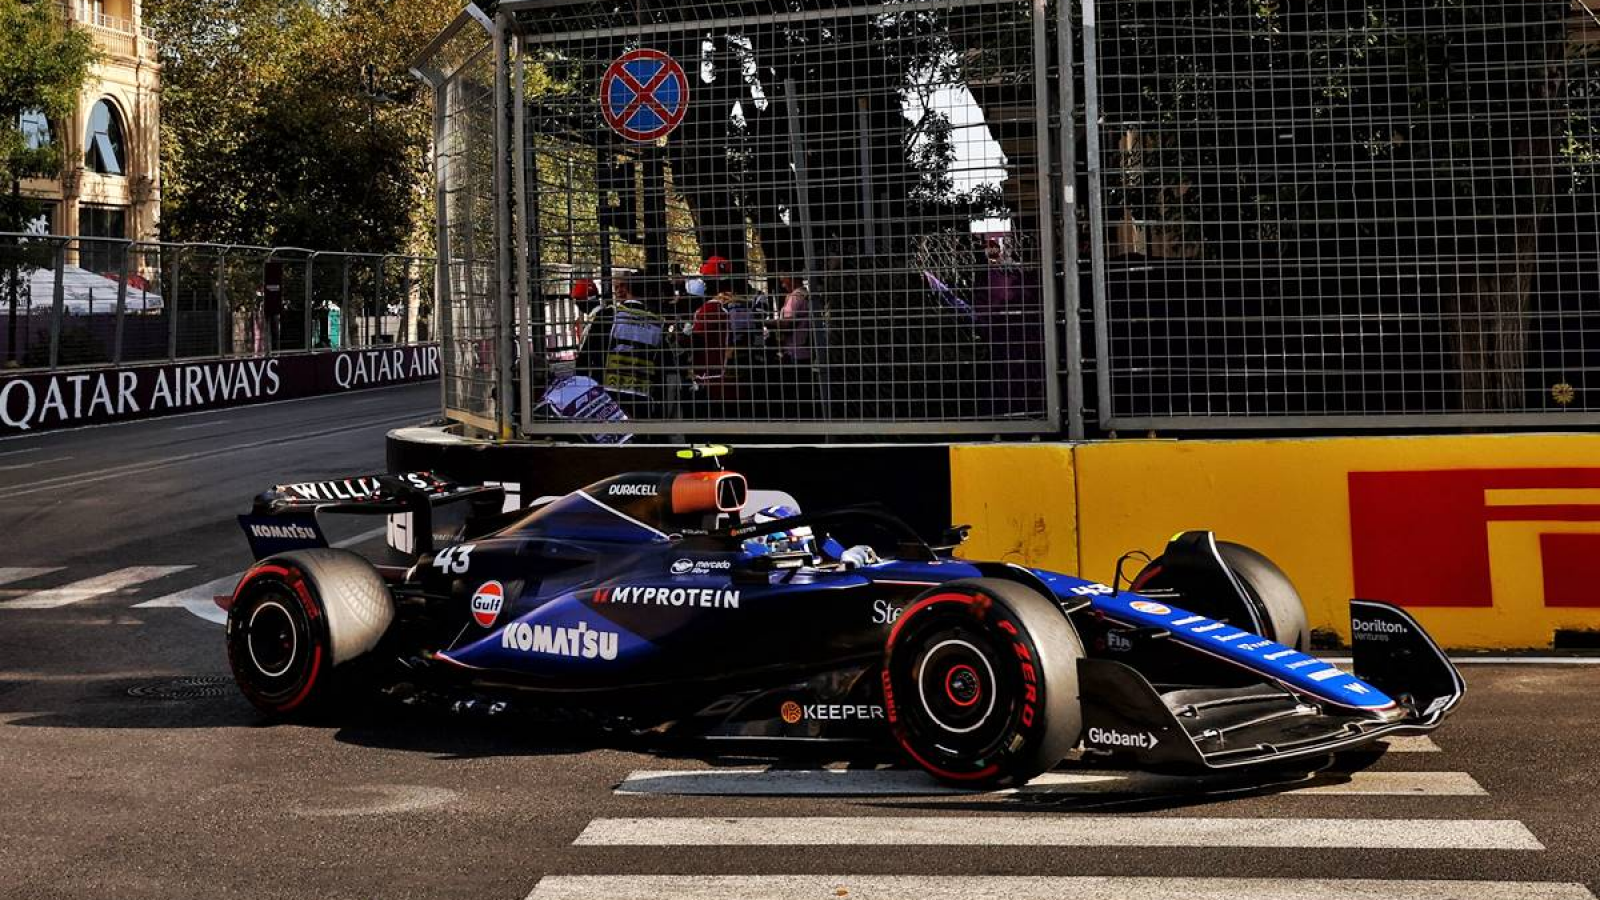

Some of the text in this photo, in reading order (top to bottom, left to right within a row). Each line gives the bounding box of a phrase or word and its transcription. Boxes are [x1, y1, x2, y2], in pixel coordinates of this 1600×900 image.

[334, 349, 405, 389] QATAR
[409, 346, 440, 377] AIR
[0, 359, 280, 429] QATAR AIRWAYS
[609, 484, 658, 496] DURACELL
[250, 524, 316, 539] KOMATSU
[433, 544, 476, 574] 43
[473, 596, 501, 612] Gulf
[611, 587, 740, 609] MYPROTEIN
[872, 599, 904, 624] Ste
[502, 622, 618, 660] KOMATSU
[1107, 633, 1131, 647] FIA
[998, 620, 1037, 727] P ZERO
[803, 704, 885, 720] KEEPER
[1088, 727, 1149, 748] Globant
